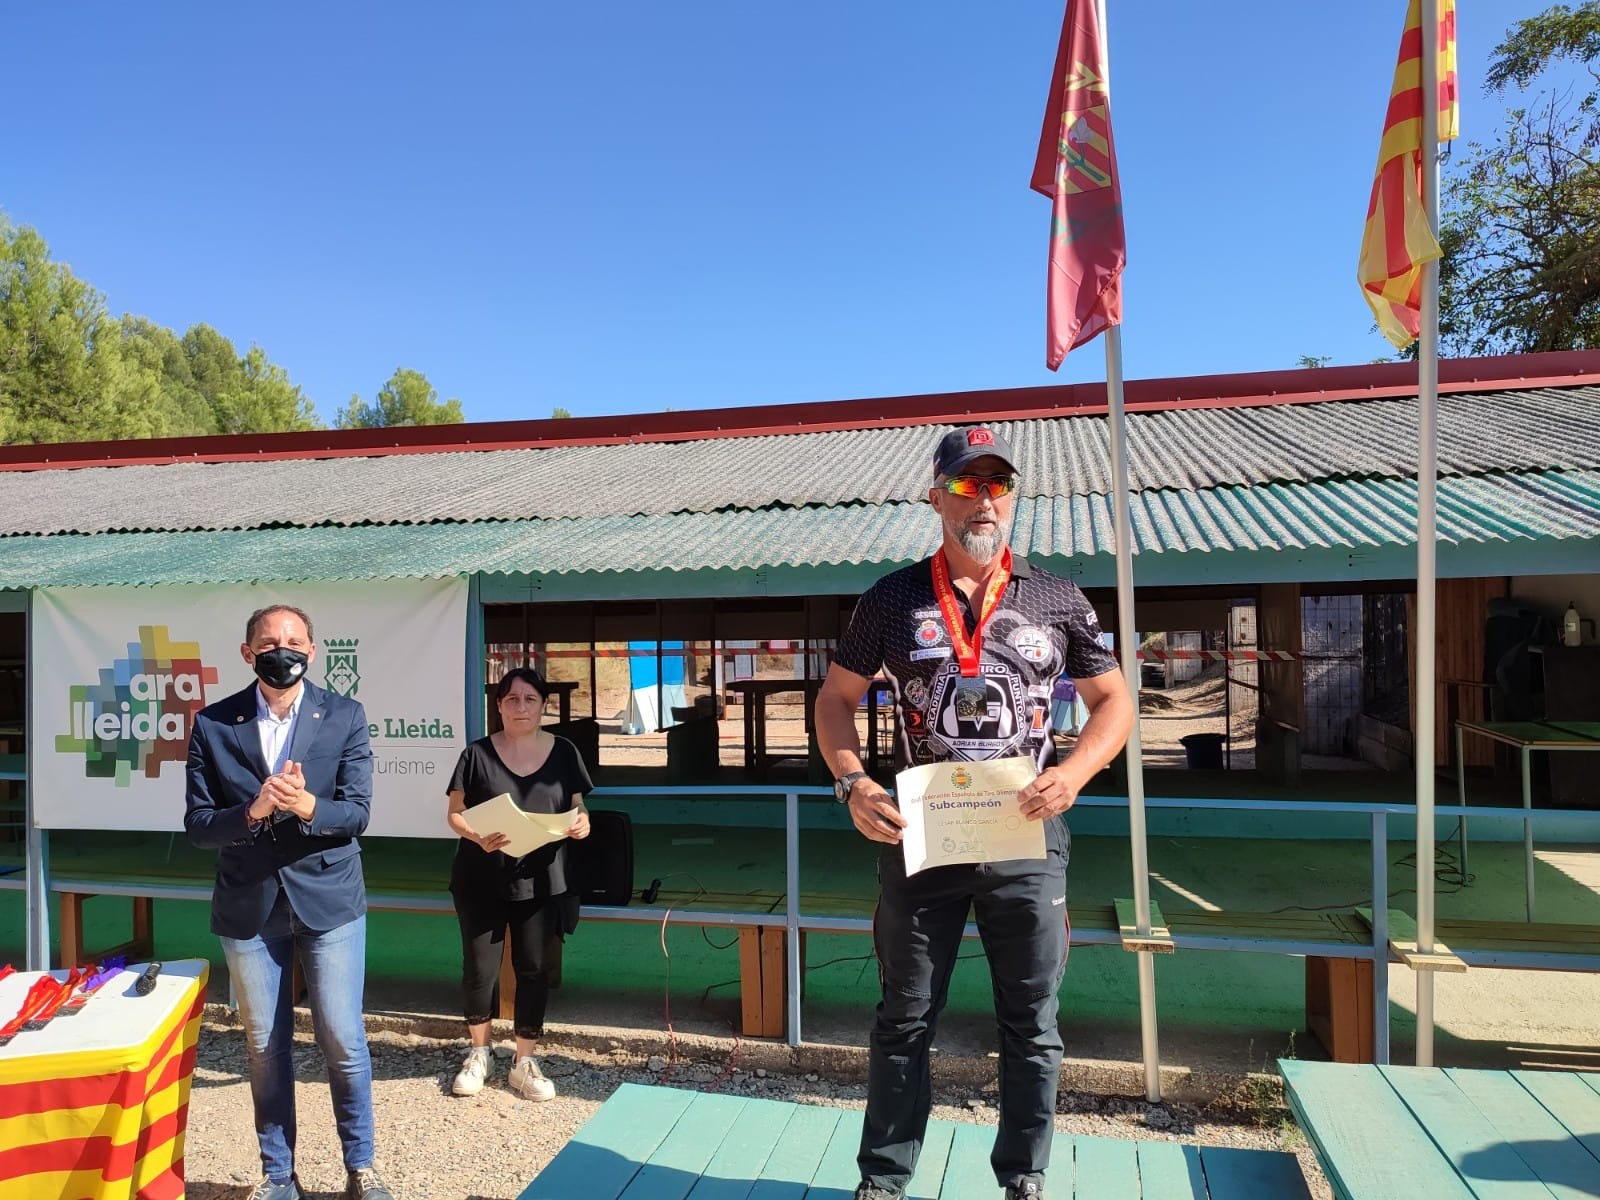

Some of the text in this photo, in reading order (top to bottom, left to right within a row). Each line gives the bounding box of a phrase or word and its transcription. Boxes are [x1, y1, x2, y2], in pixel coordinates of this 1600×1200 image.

[979, 665, 1006, 674] IRO
[129, 673, 202, 701] ara
[1010, 676, 1023, 713] PUNTO
[928, 675, 946, 729] ACADEMIA
[73, 701, 185, 740] lleida
[368, 718, 455, 739] e Lleida
[929, 799, 1002, 811] Subcampeón
